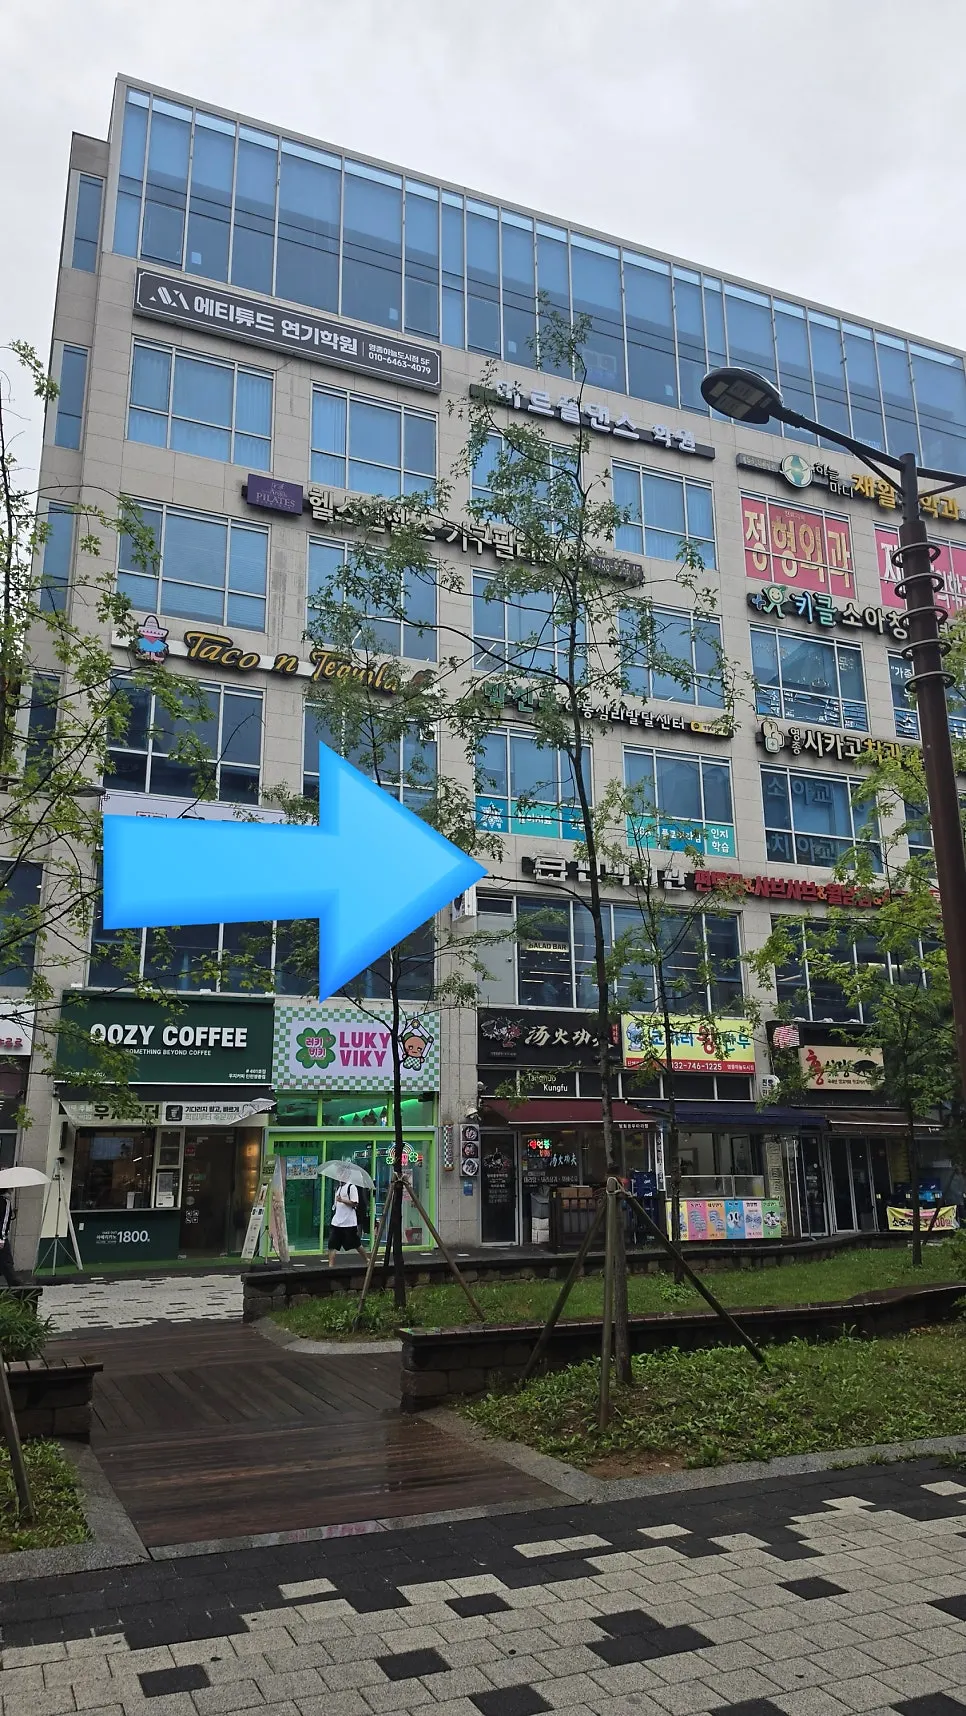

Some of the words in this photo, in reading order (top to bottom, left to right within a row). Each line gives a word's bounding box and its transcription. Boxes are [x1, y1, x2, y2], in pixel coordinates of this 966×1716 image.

[193, 295, 275, 333] 에티튜드
[281, 319, 358, 357] 연기학원
[368, 351, 431, 375] 010-6463-4079
[652, 423, 697, 454] 학원
[256, 492, 296, 508] PILATES
[829, 481, 854, 499] 마디
[743, 510, 852, 588] 정형외과
[790, 590, 838, 628] 키클
[185, 631, 261, 670] Taco
[274, 652, 299, 673] n
[710, 828, 729, 840] 인지
[711, 841, 730, 853] 학습
[90, 1023, 155, 1045] OOZY
[162, 1026, 248, 1048] COFFEE
[339, 1031, 392, 1049] LUKY
[339, 1050, 386, 1068] VIKY
[543, 1084, 568, 1096] Kungfu
